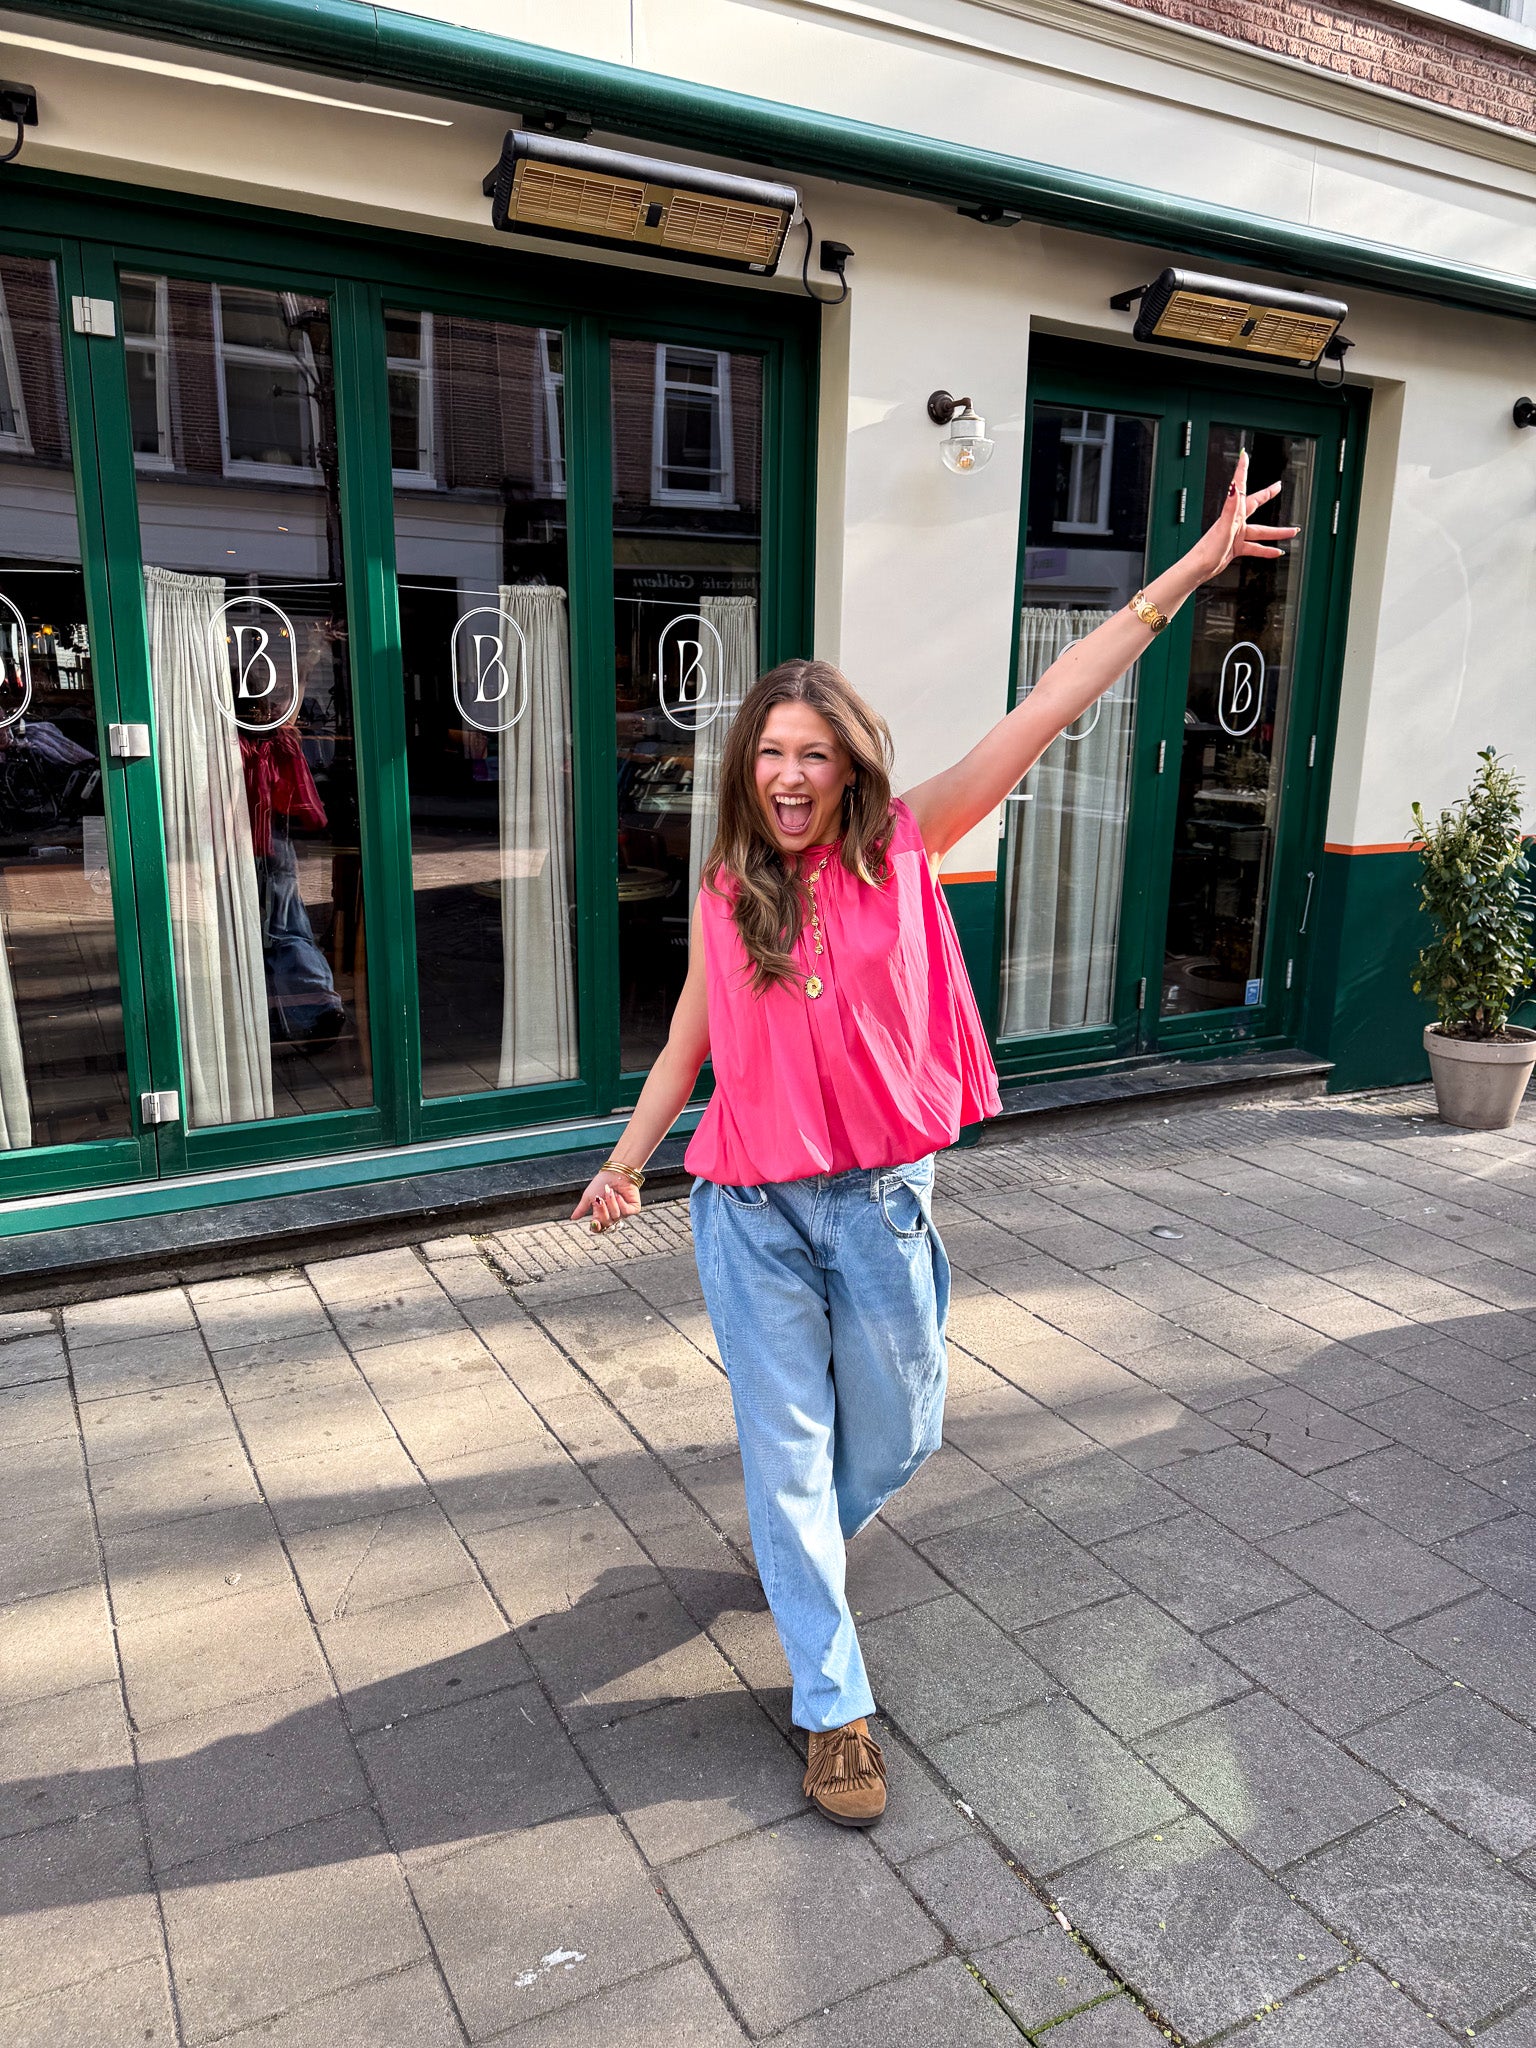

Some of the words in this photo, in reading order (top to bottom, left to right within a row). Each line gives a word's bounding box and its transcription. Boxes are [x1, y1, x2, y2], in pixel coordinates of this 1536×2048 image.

[233, 626, 277, 698] B
[473, 635, 509, 702] B
[678, 641, 707, 702] B
[1230, 662, 1252, 713] B
